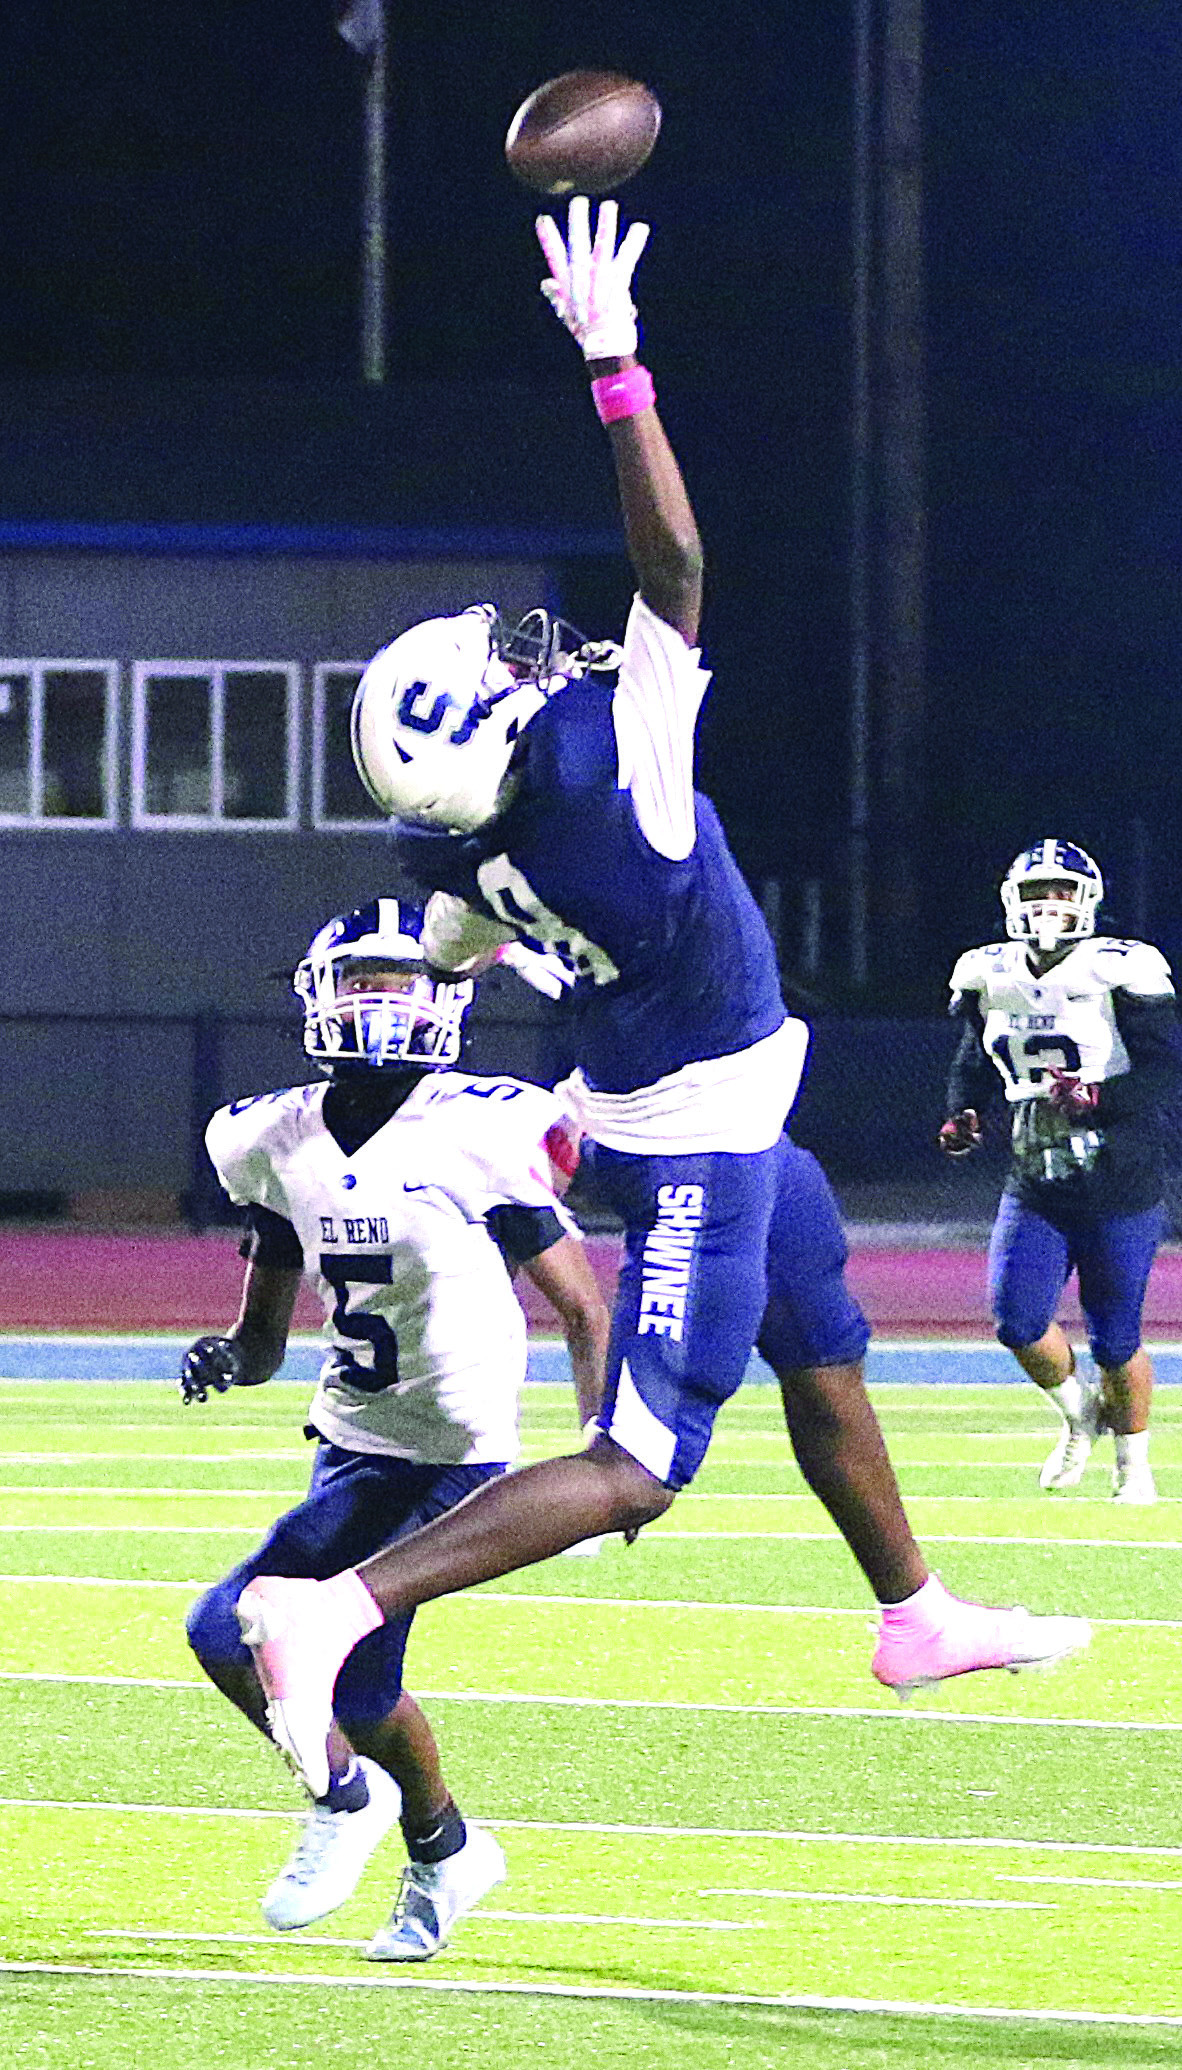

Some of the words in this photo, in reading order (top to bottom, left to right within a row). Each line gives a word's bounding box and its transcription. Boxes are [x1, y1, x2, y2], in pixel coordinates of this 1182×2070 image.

[319, 1216, 339, 1244] EL
[343, 1216, 390, 1244] RENO
[637, 1183, 705, 1343] SHAWNEE
[318, 1252, 399, 1393] 5
